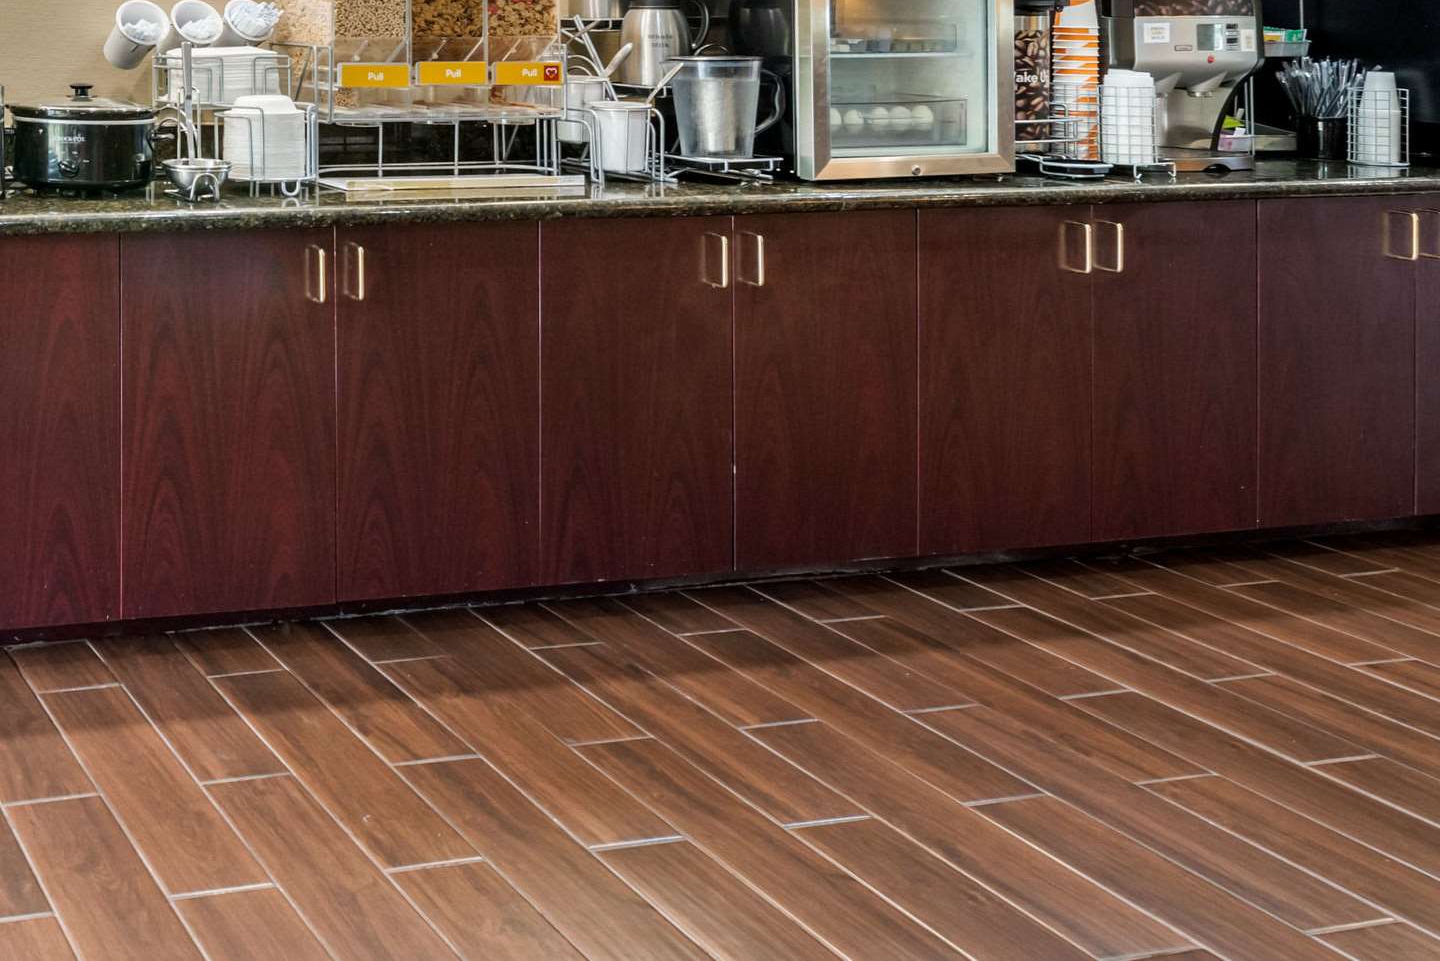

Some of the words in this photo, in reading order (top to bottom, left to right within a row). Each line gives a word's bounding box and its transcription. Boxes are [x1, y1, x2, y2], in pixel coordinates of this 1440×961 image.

[367, 71, 385, 81] Pull
[444, 68, 462, 79] Pull
[521, 67, 538, 77] Pull
[1013, 71, 1039, 83] ake
